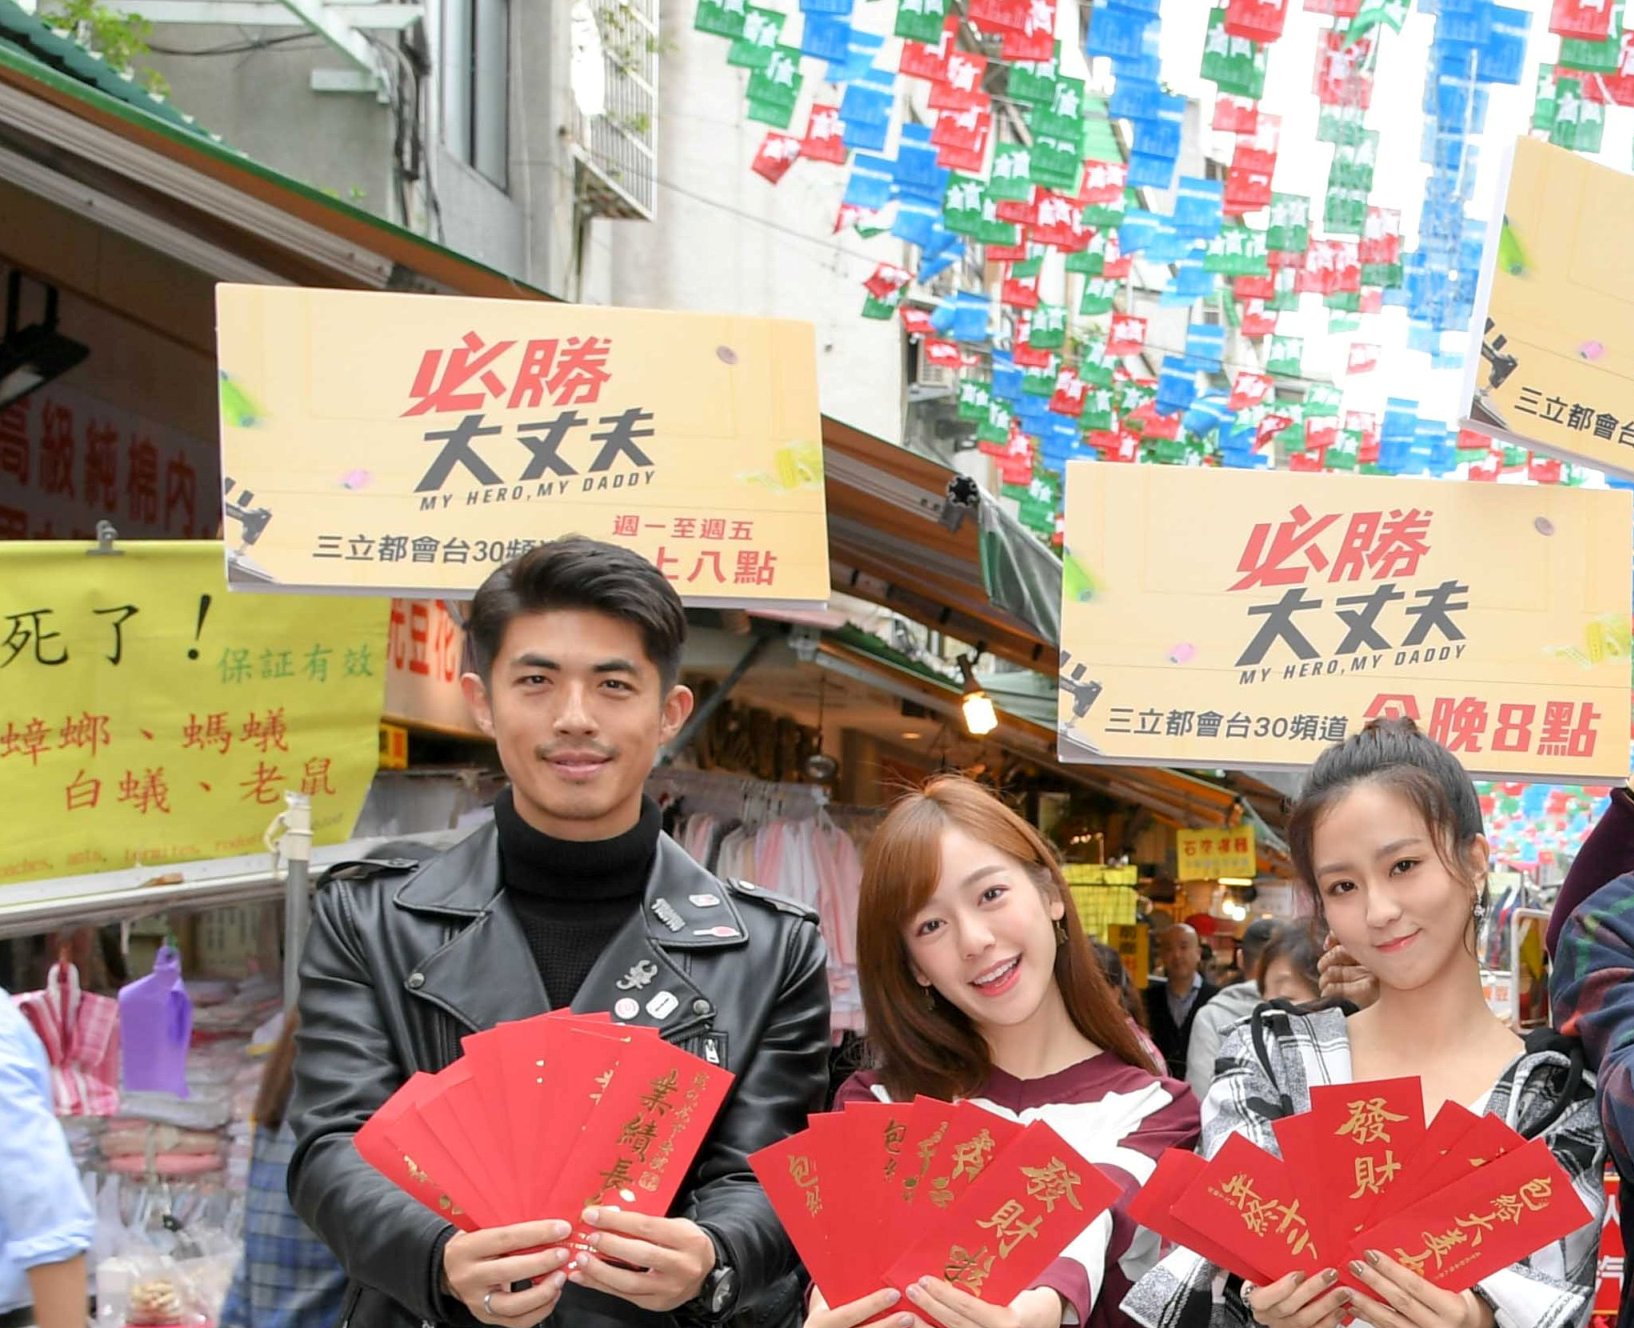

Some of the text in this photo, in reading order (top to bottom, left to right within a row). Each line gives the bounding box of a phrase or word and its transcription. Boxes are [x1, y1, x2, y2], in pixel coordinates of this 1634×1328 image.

[399, 331, 612, 417] 必勝
[0, 396, 198, 538] 高級純棉內
[414, 407, 655, 493] 大丈夫
[419, 495, 453, 511] MY
[582, 471, 656, 492] DADDY
[312, 534, 552, 564] 三立都會台30頻
[612, 515, 754, 541] 週一至週五
[1226, 504, 1435, 591] 必勝
[1234, 579, 1469, 667] 大丈夫
[218, 643, 374, 684] 保証有效
[1239, 667, 1271, 685] MY
[1394, 644, 1467, 666] DADDY
[1104, 707, 1349, 742] 三立都會台30頻道
[65, 756, 337, 815] 白蟻、老鼠
[1221, 1172, 1318, 1260] 年終十二
